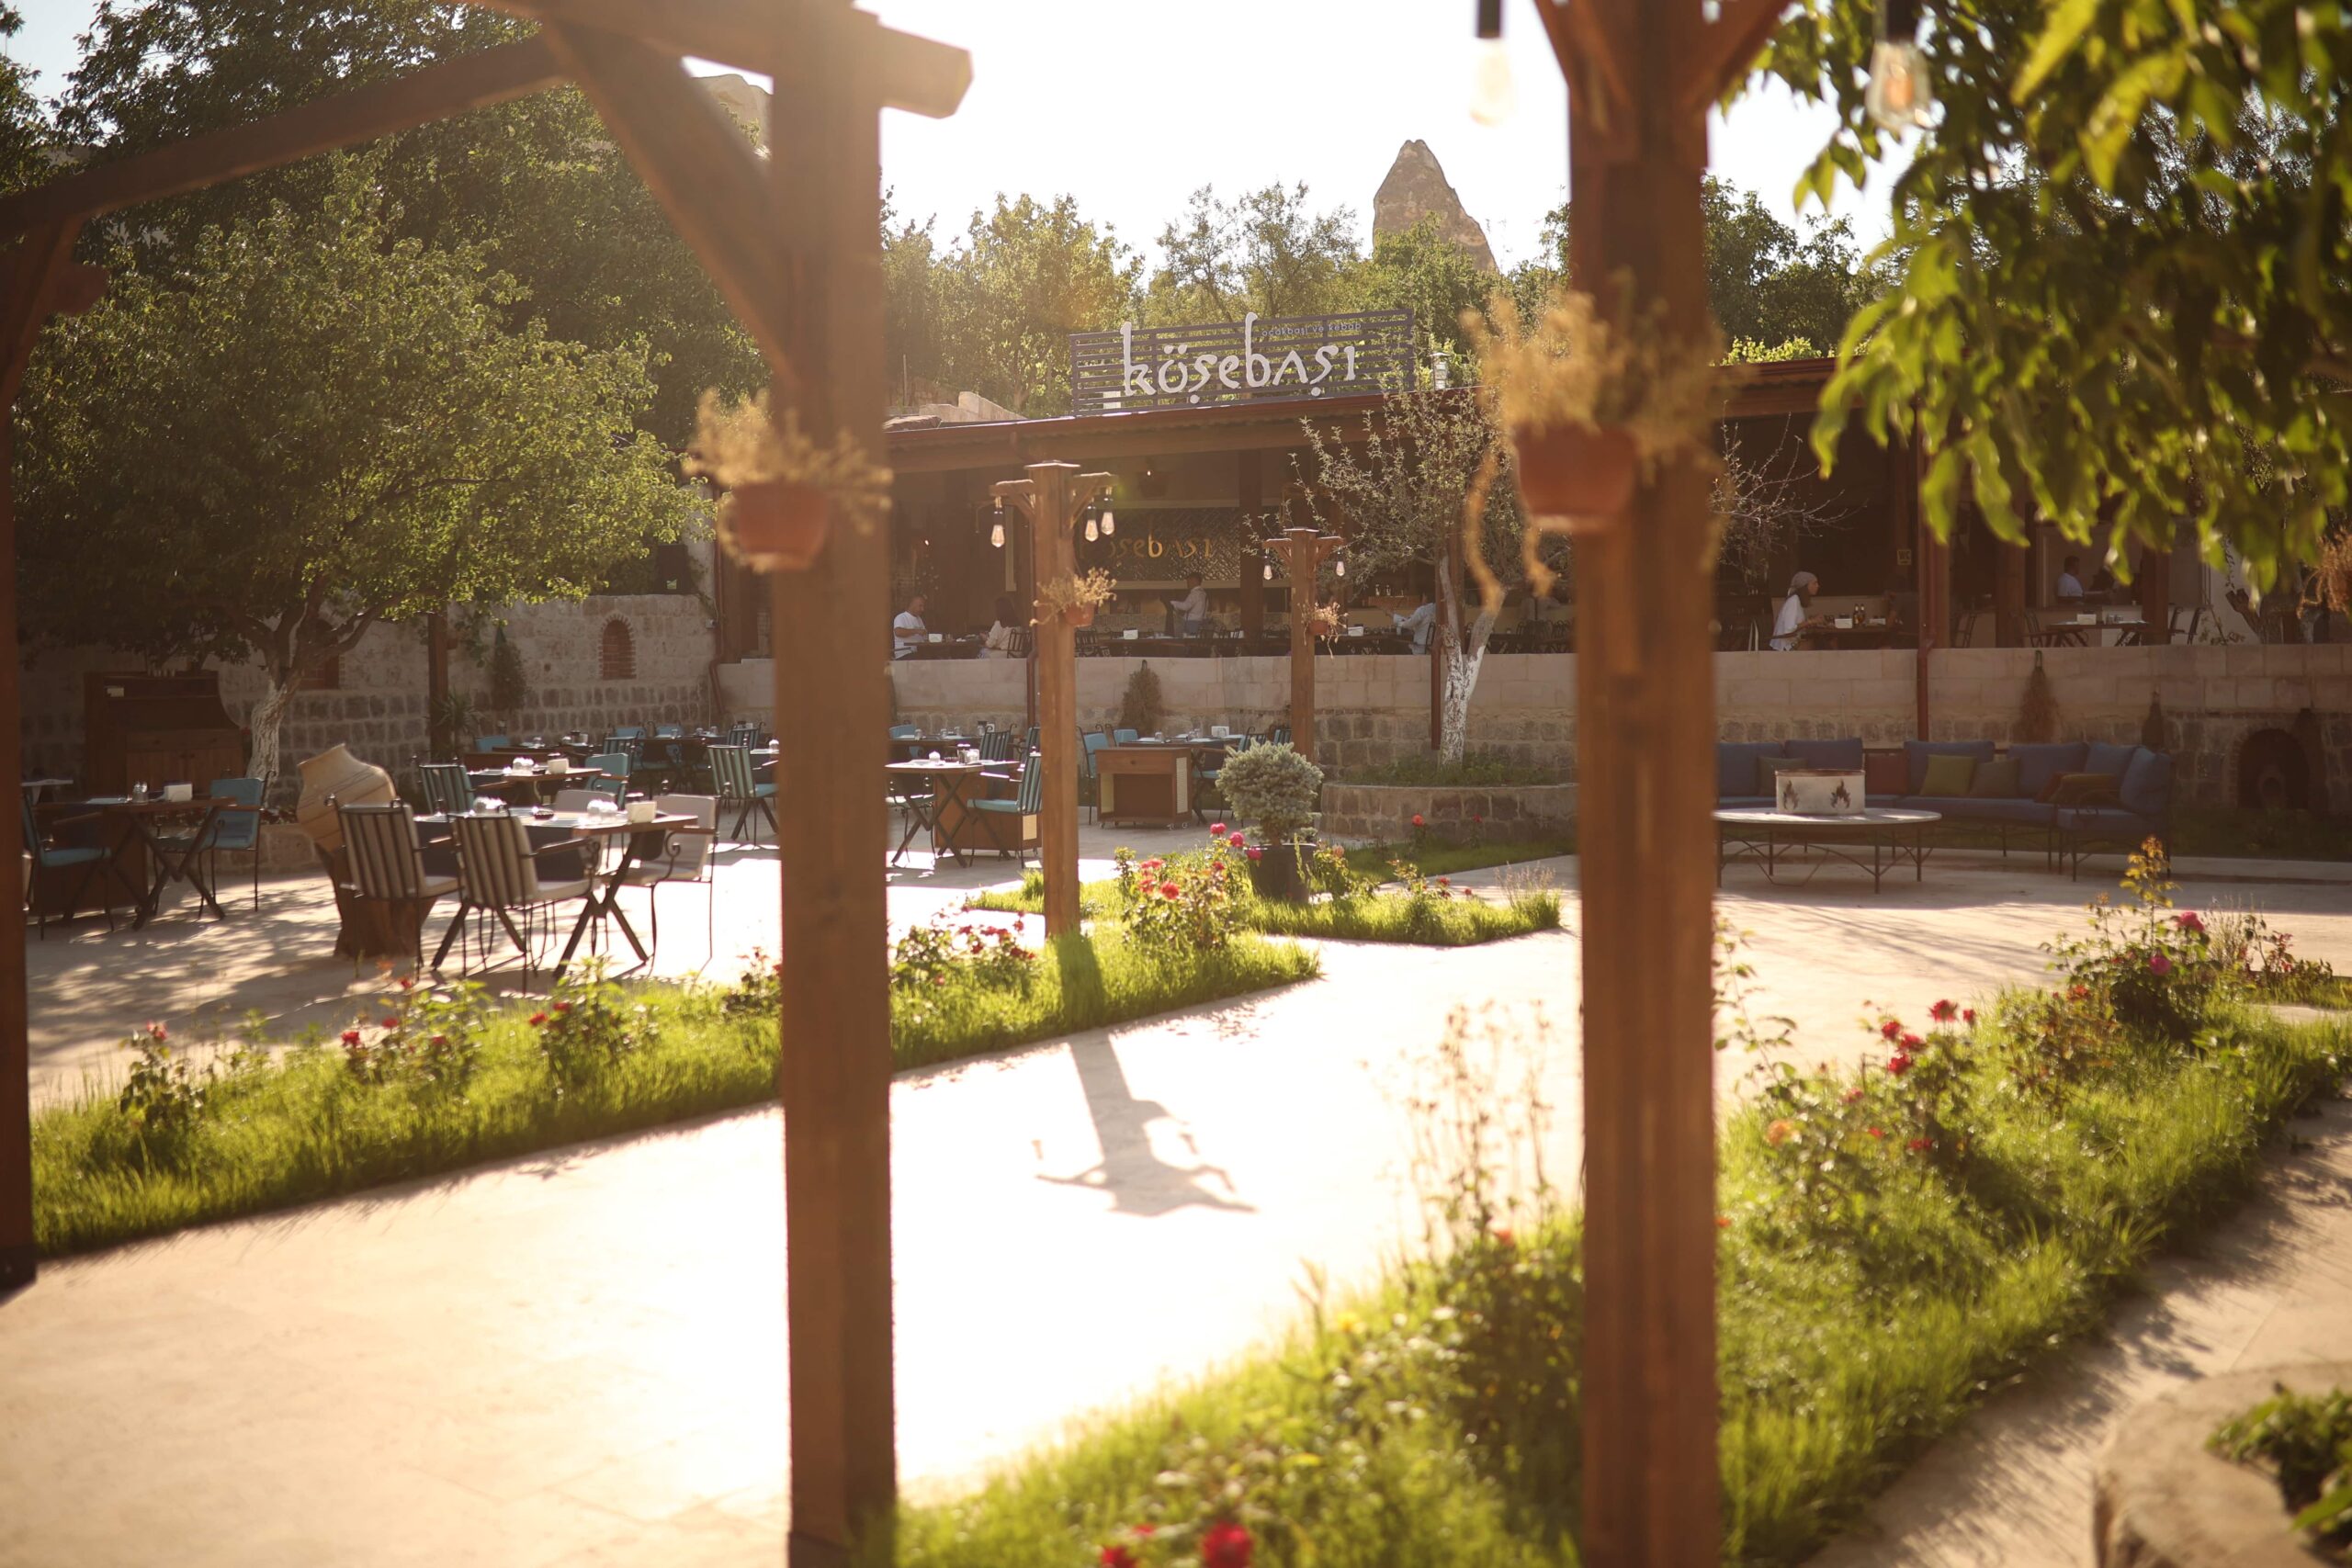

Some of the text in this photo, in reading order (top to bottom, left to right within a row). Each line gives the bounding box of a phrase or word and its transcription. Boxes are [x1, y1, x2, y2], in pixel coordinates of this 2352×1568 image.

[1261, 326, 1308, 337] ocakbaşı
[1329, 322, 1362, 332] kebap
[1120, 312, 1355, 403] köşebaşı
